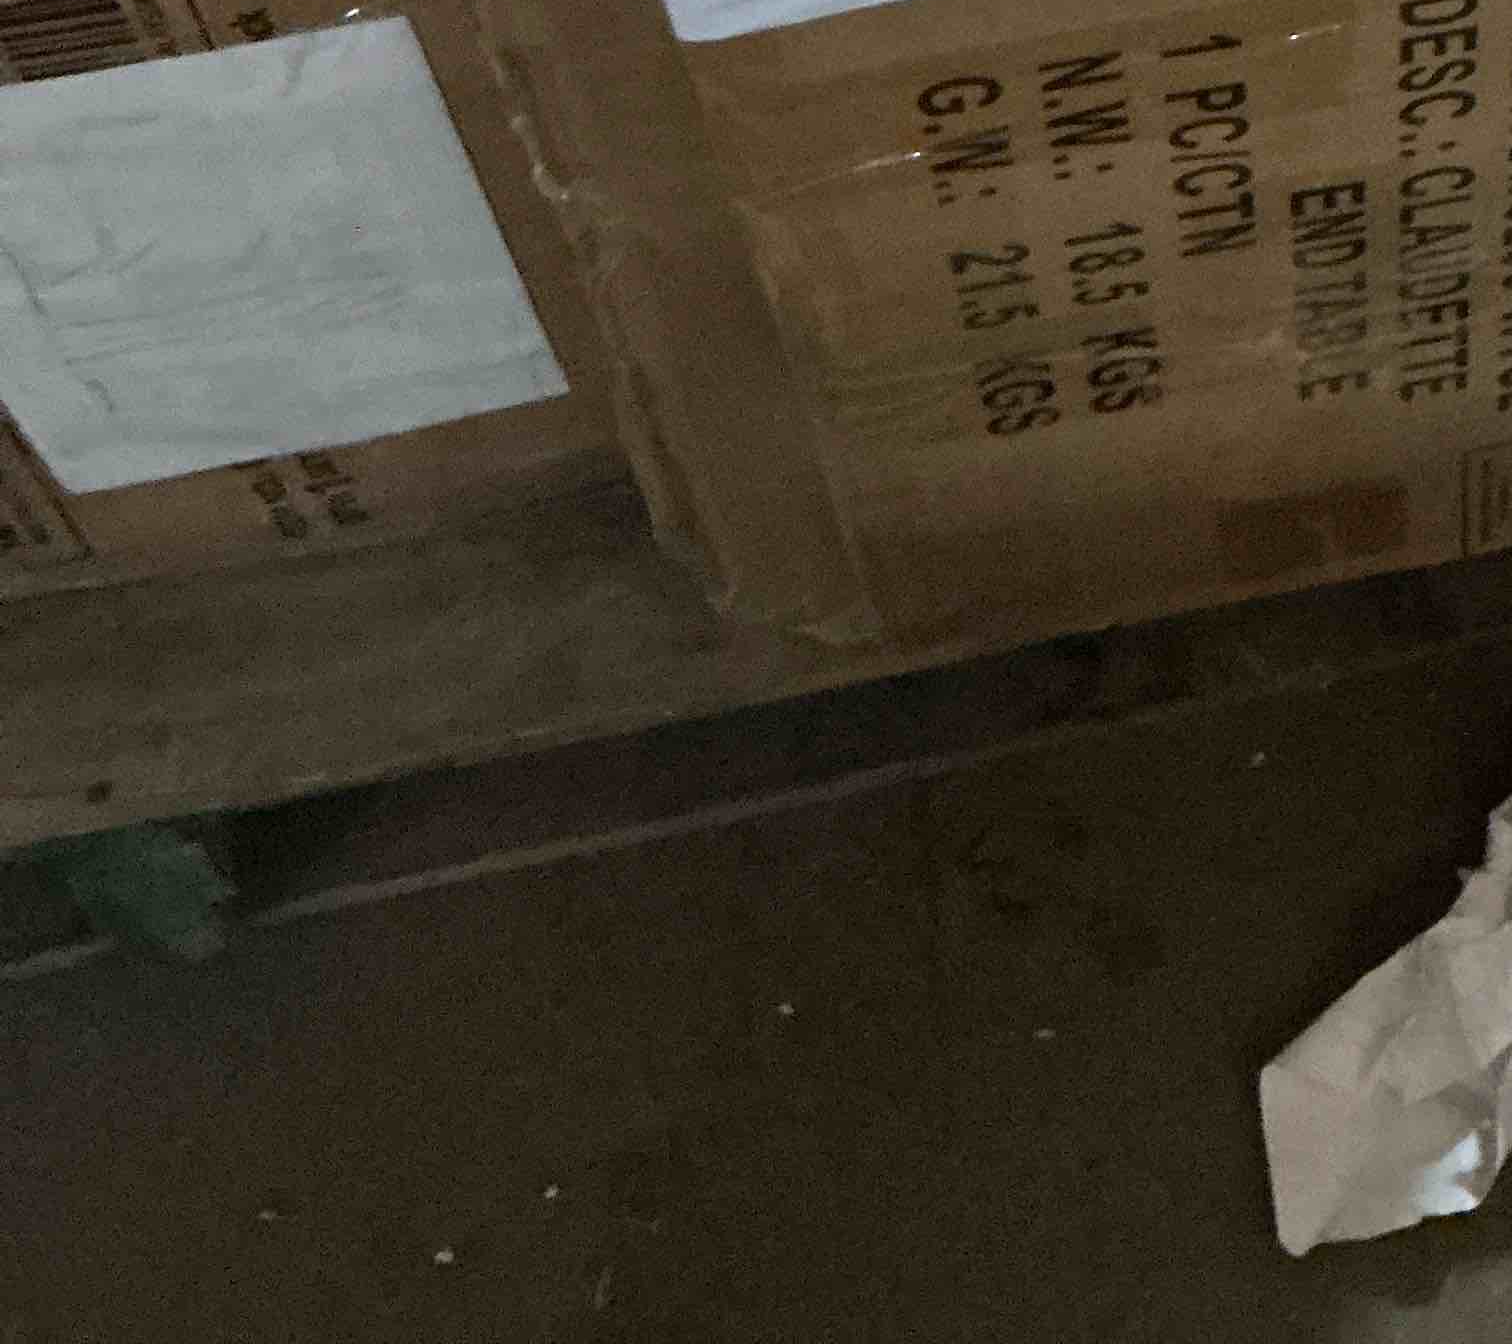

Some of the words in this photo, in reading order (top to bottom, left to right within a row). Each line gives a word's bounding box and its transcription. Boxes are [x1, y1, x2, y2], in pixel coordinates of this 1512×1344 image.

[1161, 35, 1242, 58] 1
[1165, 82, 1256, 258] PC/CTN
[1064, 222, 1149, 305] 18.5
[1290, 181, 1367, 268] END
[950, 243, 1039, 329] 21.5
[1398, 166, 1476, 402] CLAUDETTE
[1081, 326, 1164, 413] KGS
[1295, 272, 1370, 402] TABLE
[977, 360, 1061, 436] KGS
